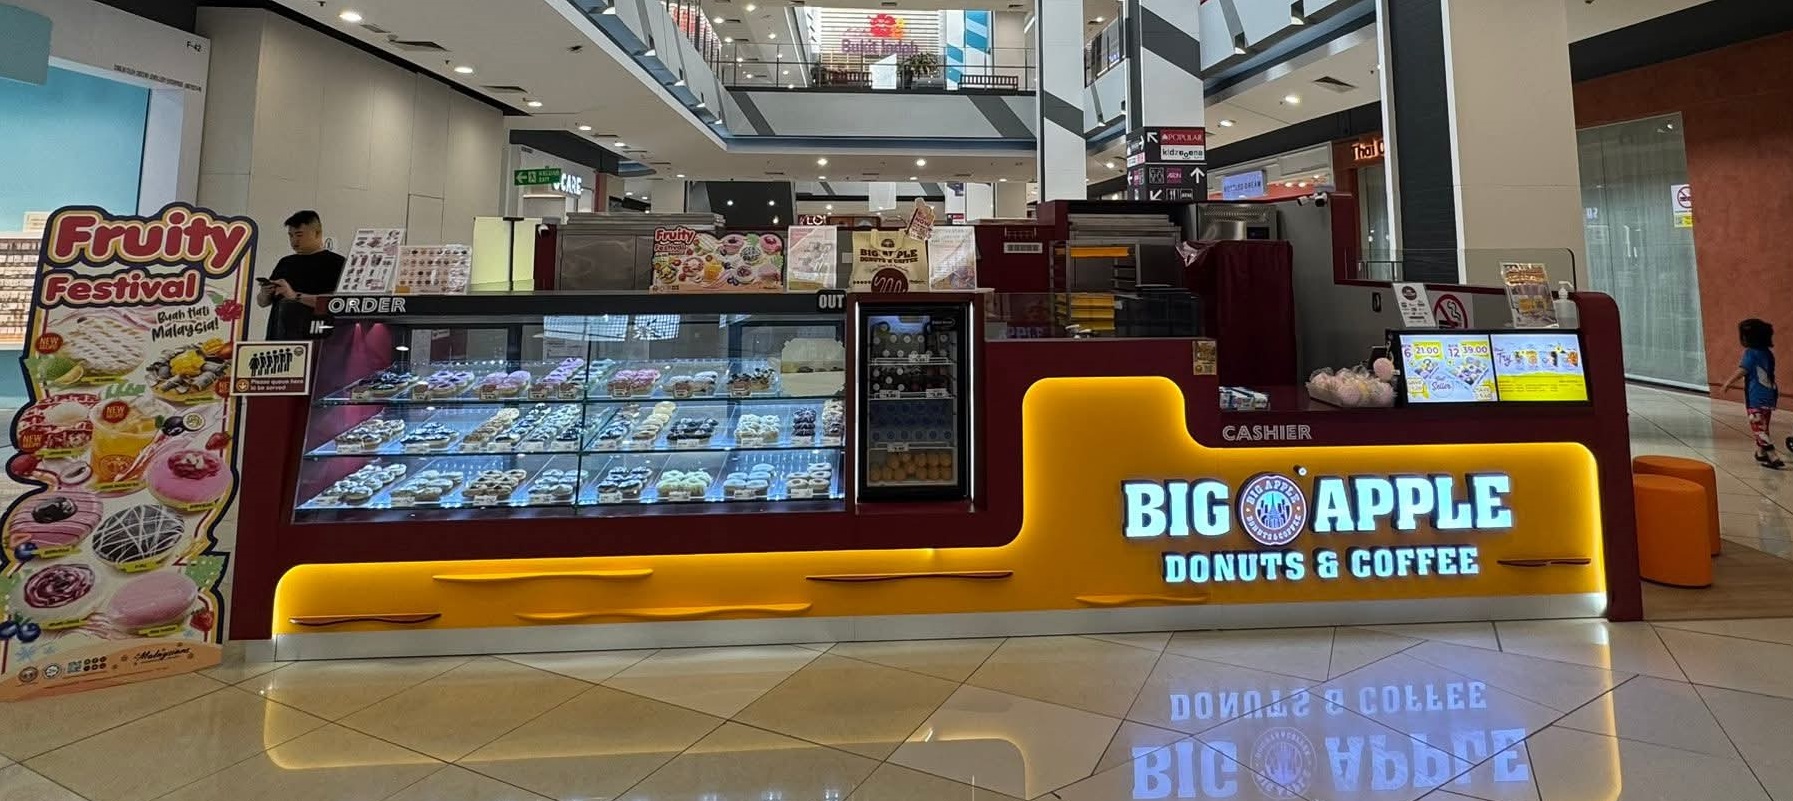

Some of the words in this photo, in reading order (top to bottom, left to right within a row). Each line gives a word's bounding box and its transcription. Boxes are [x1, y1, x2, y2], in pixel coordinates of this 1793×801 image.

[1352, 140, 1376, 160] Thai
[54, 211, 246, 270] Fruity
[656, 228, 694, 243] Fruity
[860, 249, 879, 257] BIG
[45, 273, 197, 301] Festival
[328, 297, 407, 313] ORDER
[818, 294, 845, 309] OUT
[158, 309, 185, 324] Buah
[187, 306, 210, 319] Hati
[152, 317, 219, 342] Malaysia!
[309, 320, 325, 334] IN
[1416, 346, 1439, 354] 21.00
[1448, 348, 1460, 358] 12
[1463, 346, 1488, 354] 39.00
[1222, 424, 1312, 441] CASHIER
[1246, 485, 1263, 505] BIG
[1265, 479, 1300, 504] APPLE
[1124, 479, 1230, 538] BIG
[1311, 473, 1513, 533] APPLE
[1163, 551, 1306, 584] DONUTS
[1316, 549, 1339, 580] &
[1350, 546, 1480, 577] COFFEE
